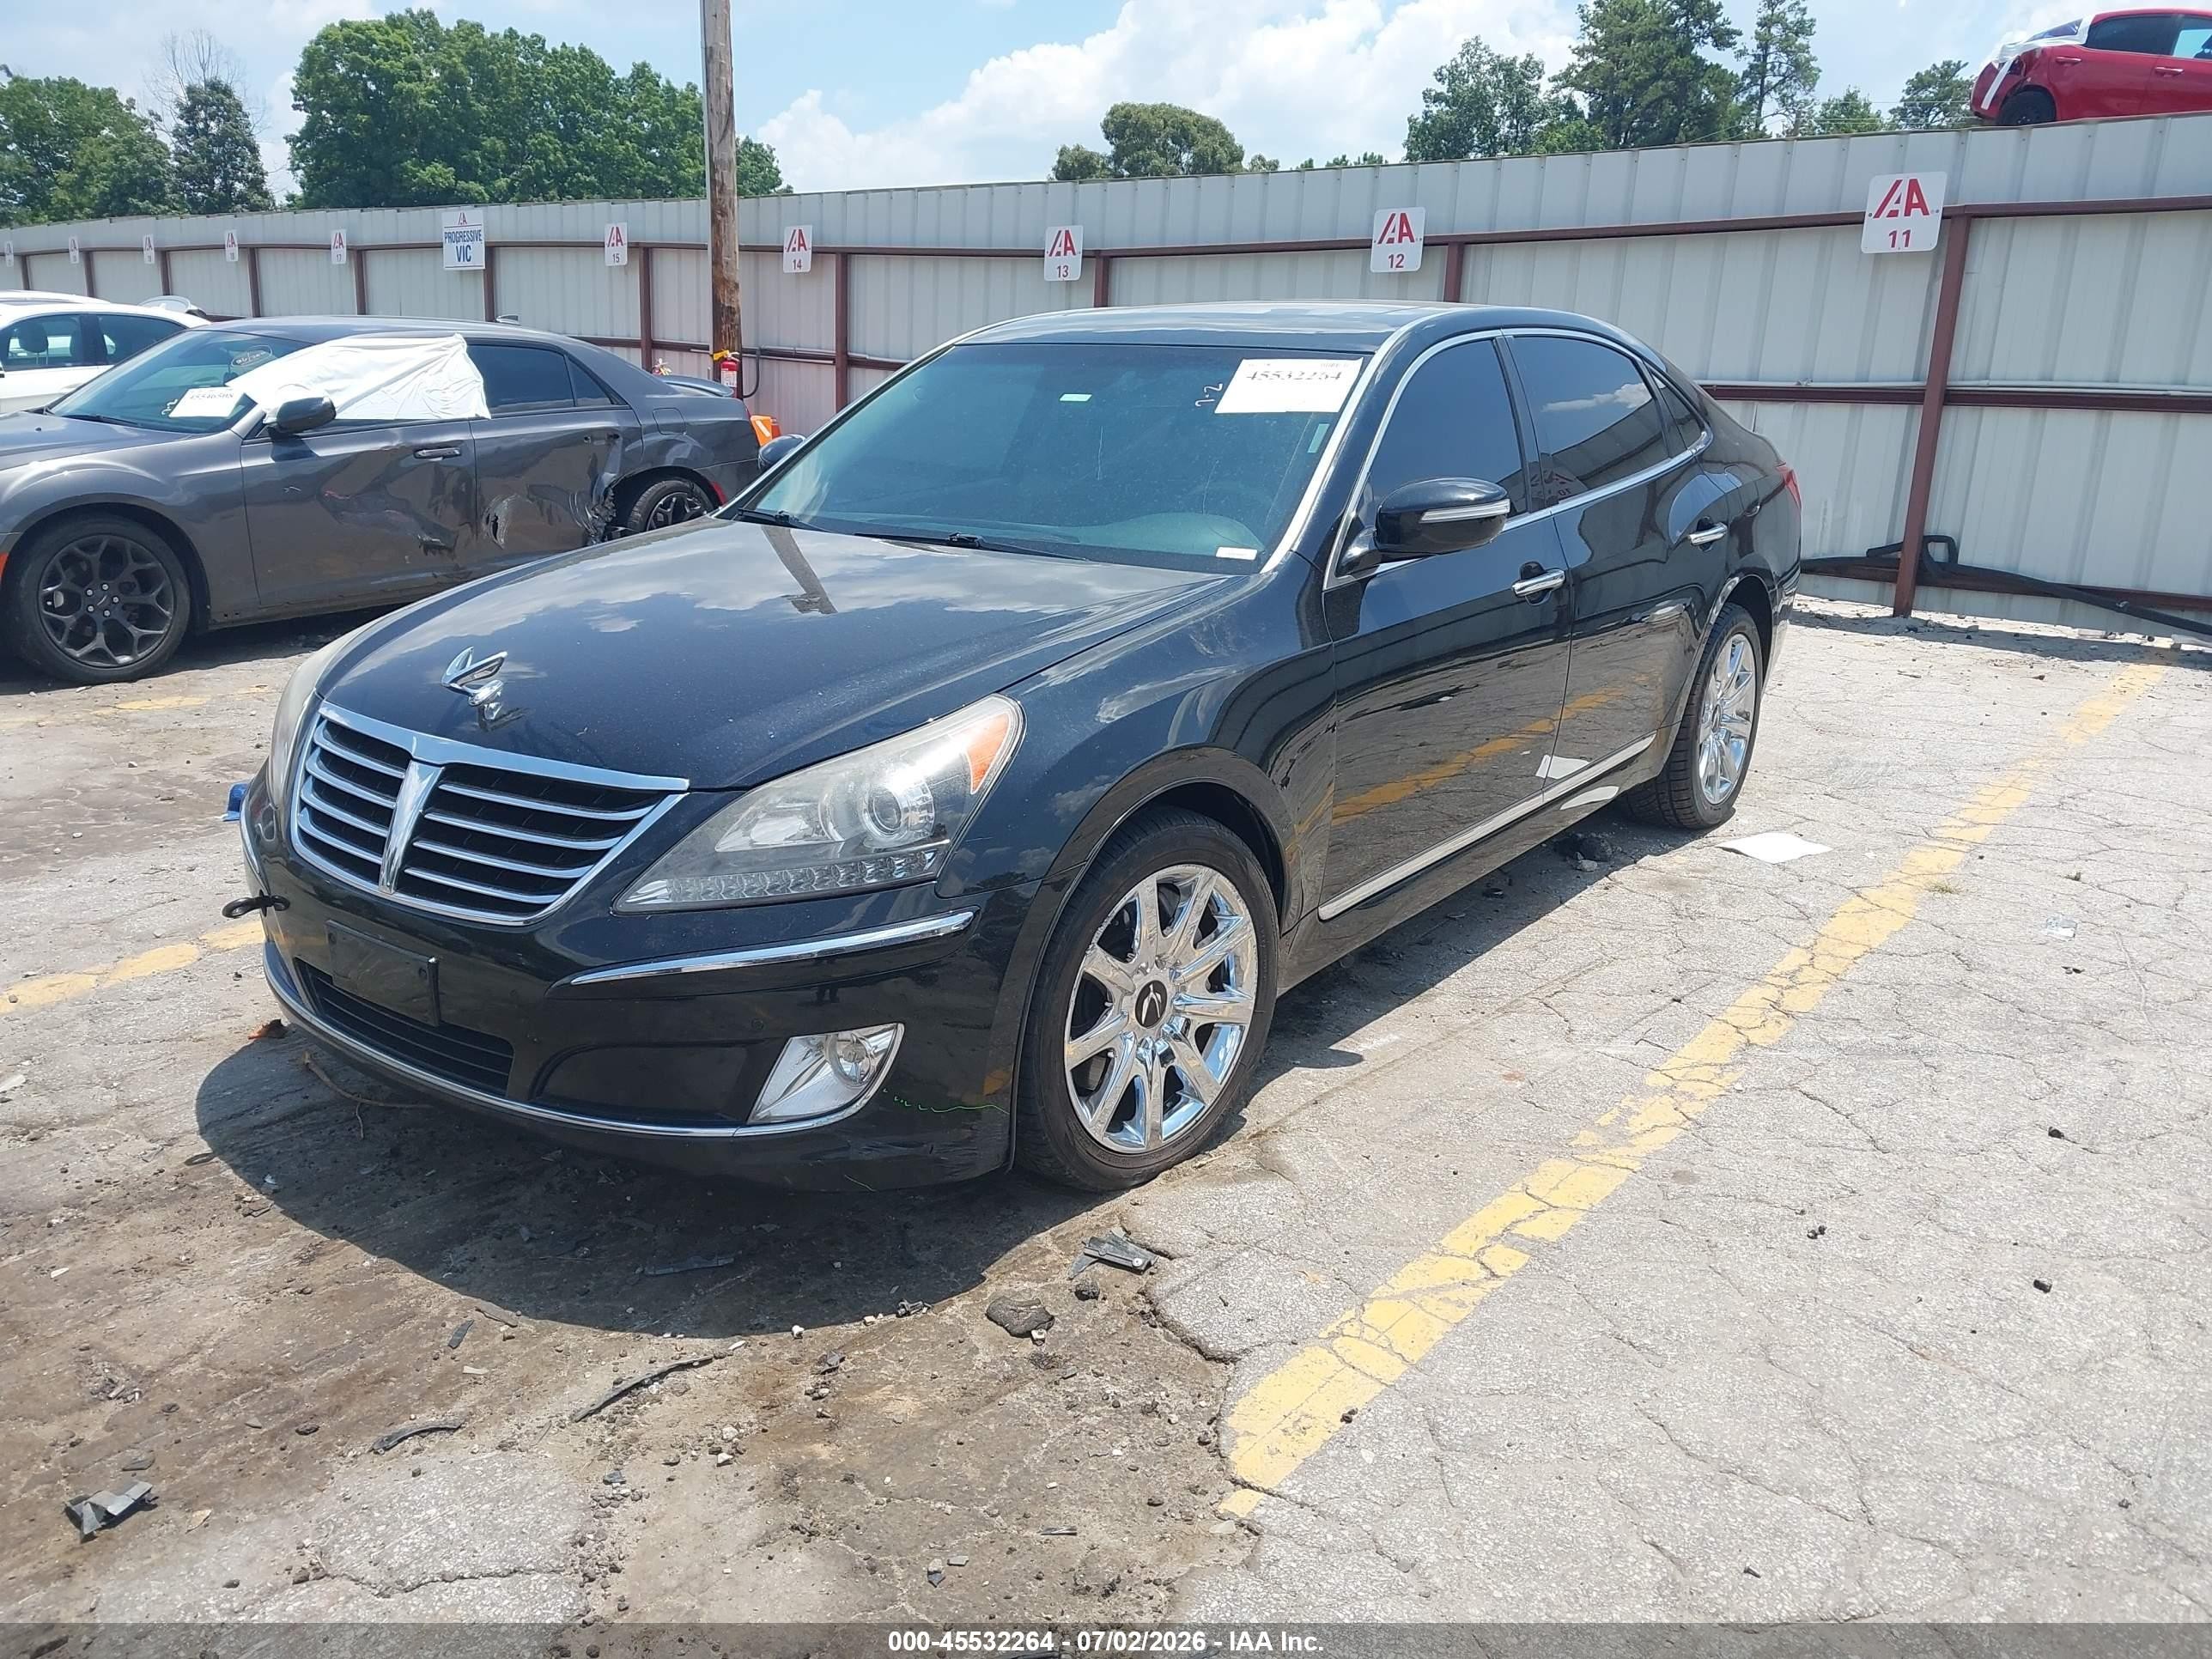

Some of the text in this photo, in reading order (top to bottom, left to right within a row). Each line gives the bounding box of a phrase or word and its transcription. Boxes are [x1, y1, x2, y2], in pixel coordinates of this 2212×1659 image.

[444, 229, 483, 243] PROGRESSIVE
[1888, 229, 1911, 248] 11
[455, 246, 472, 263] VIC
[611, 253, 620, 264] 15
[1388, 253, 1405, 269] 12
[792, 258, 802, 270] 14
[1056, 264, 1069, 278] 13
